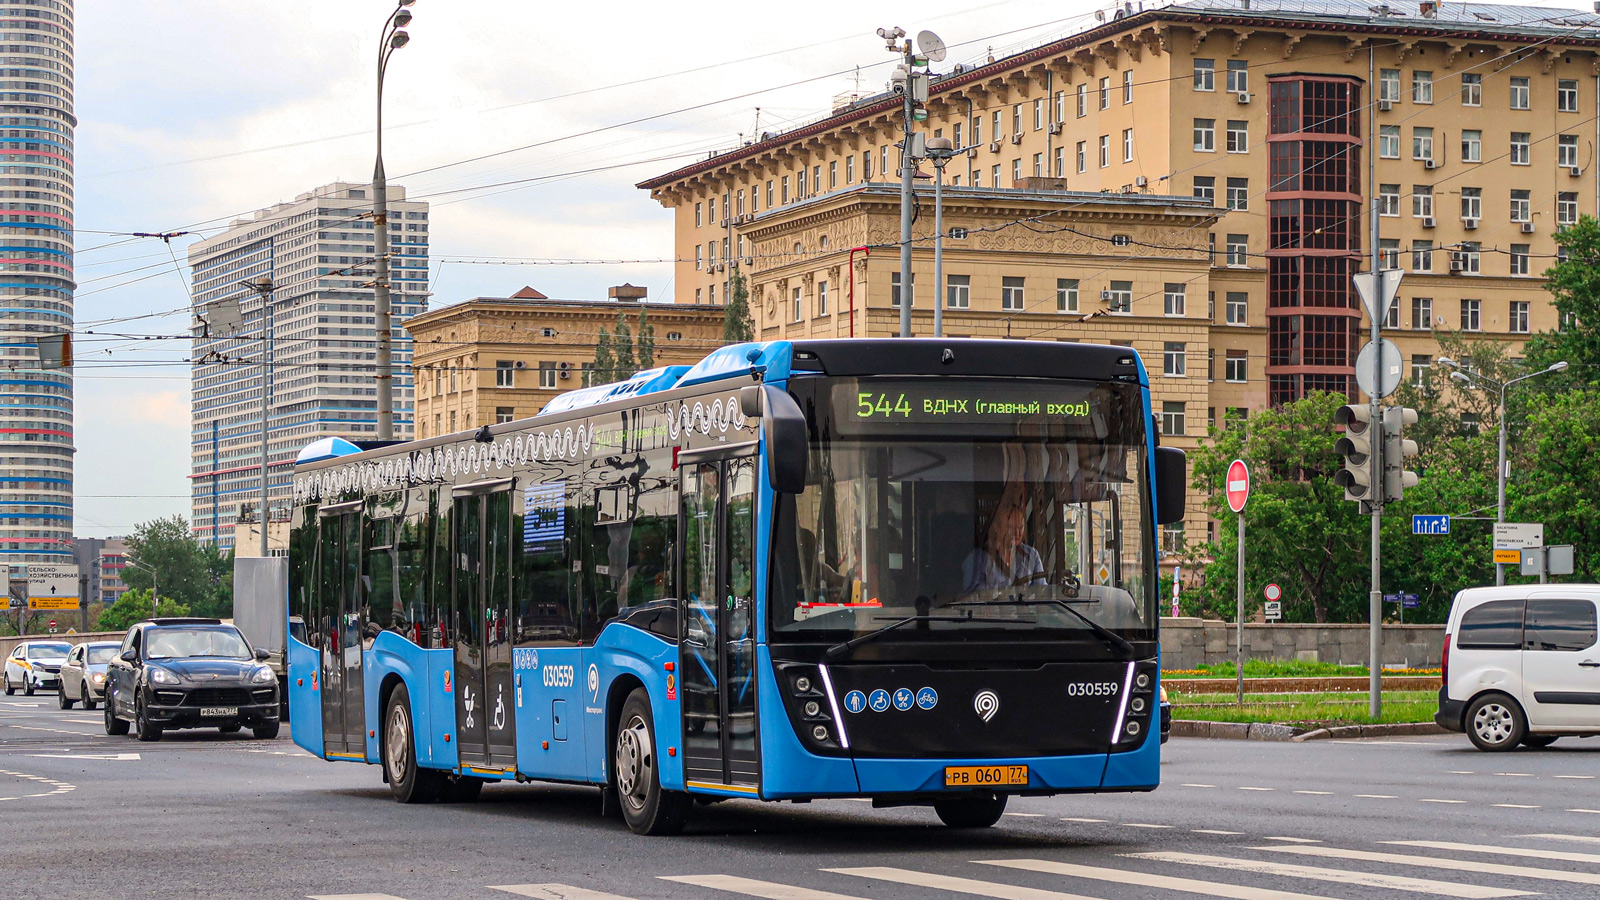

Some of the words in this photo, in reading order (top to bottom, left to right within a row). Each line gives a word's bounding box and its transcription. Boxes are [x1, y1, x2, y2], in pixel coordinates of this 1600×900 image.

[857, 393, 912, 417] 544
[923, 399, 969, 415] ВДНХ
[975, 398, 1040, 415] (главный
[1046, 400, 1091, 416] вход)
[595, 428, 612, 450] 544
[542, 665, 574, 688] 030559
[1067, 682, 1119, 696] 030559
[952, 772, 970, 783] РВ
[975, 768, 1002, 783] 060
[1009, 767, 1023, 778] 77
